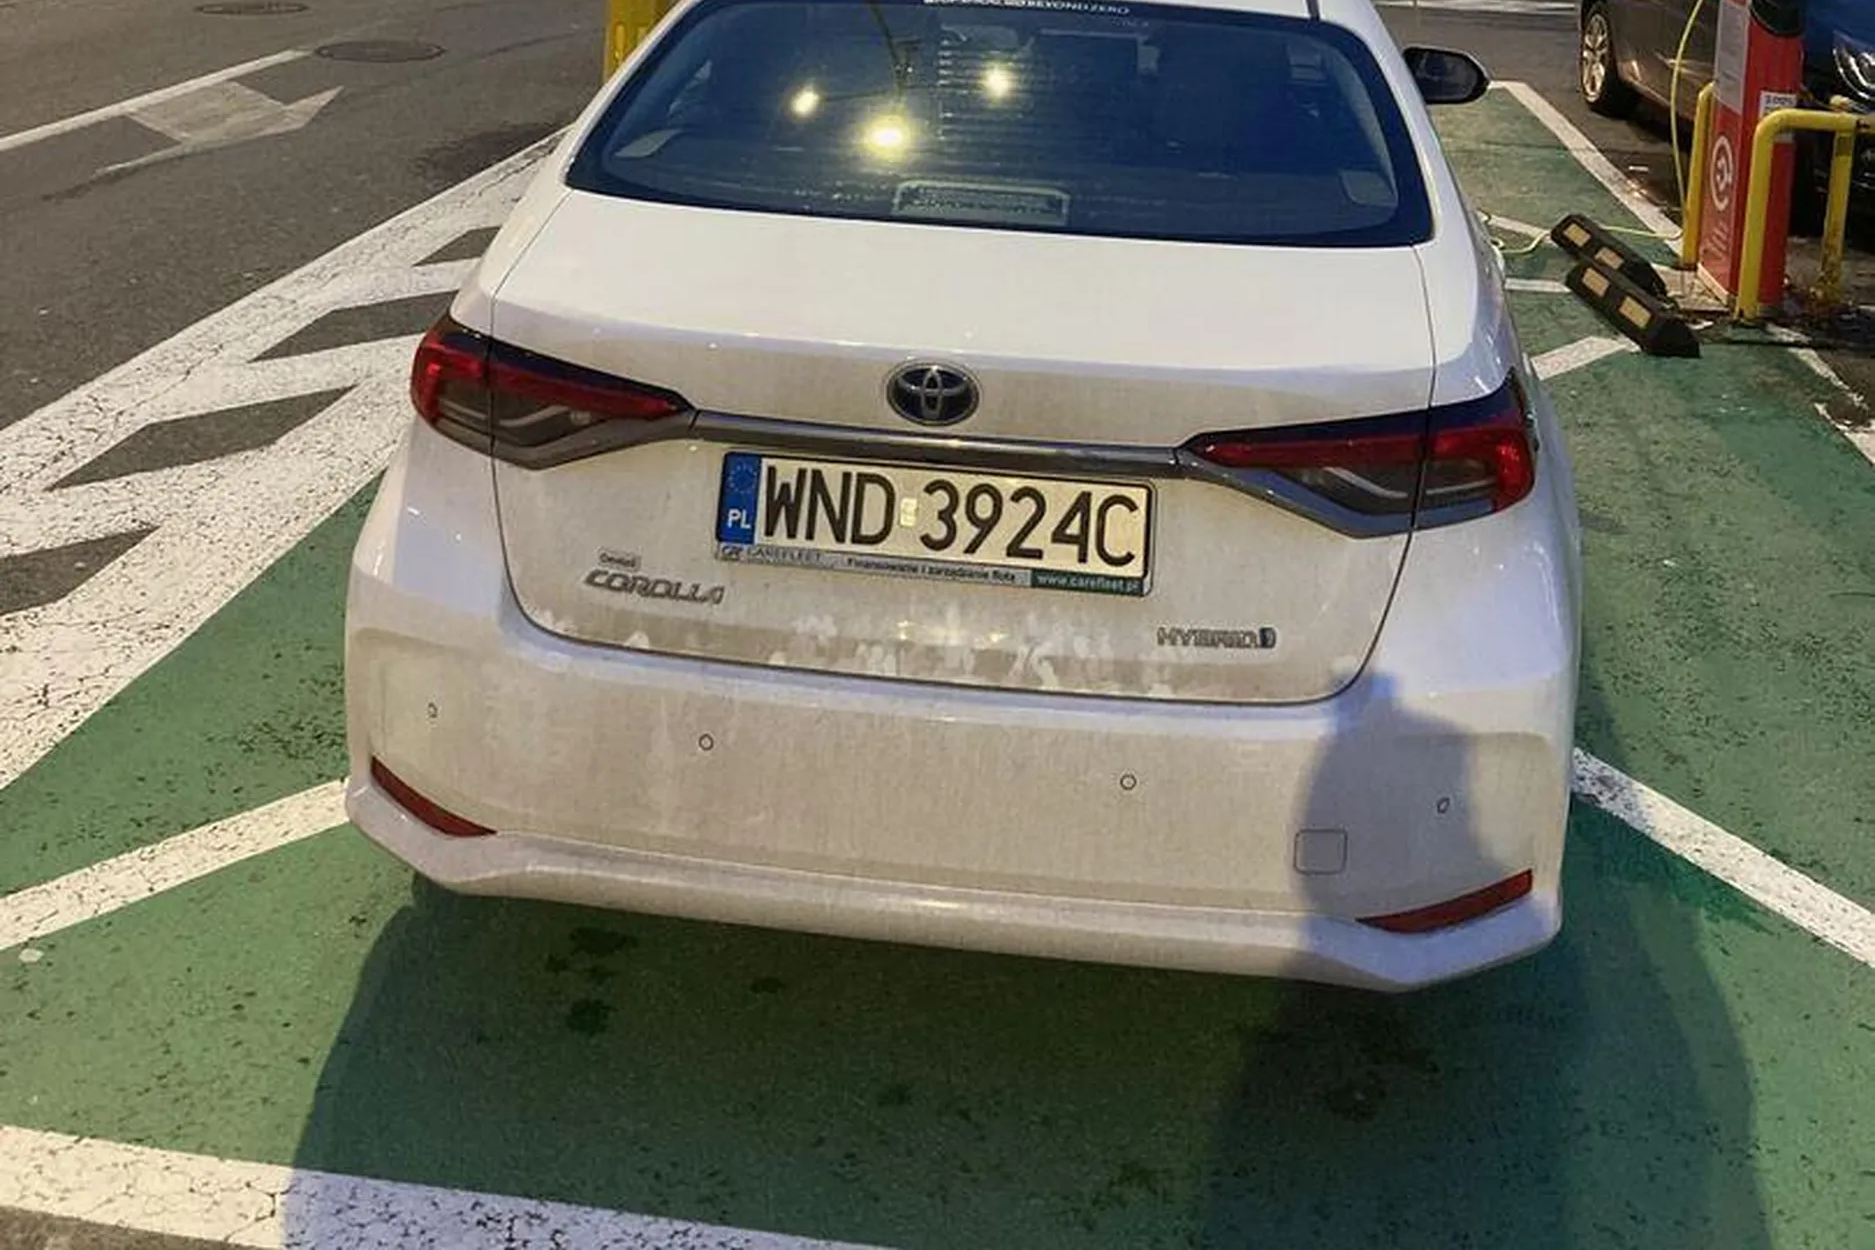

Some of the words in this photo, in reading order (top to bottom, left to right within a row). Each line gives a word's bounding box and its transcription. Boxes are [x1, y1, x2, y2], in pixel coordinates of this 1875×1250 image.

[728, 508, 752, 531] PL
[764, 465, 896, 546] WND
[920, 478, 1140, 568] 3924C
[584, 568, 726, 605] COROLLA
[1156, 626, 1260, 649] HYBRID
